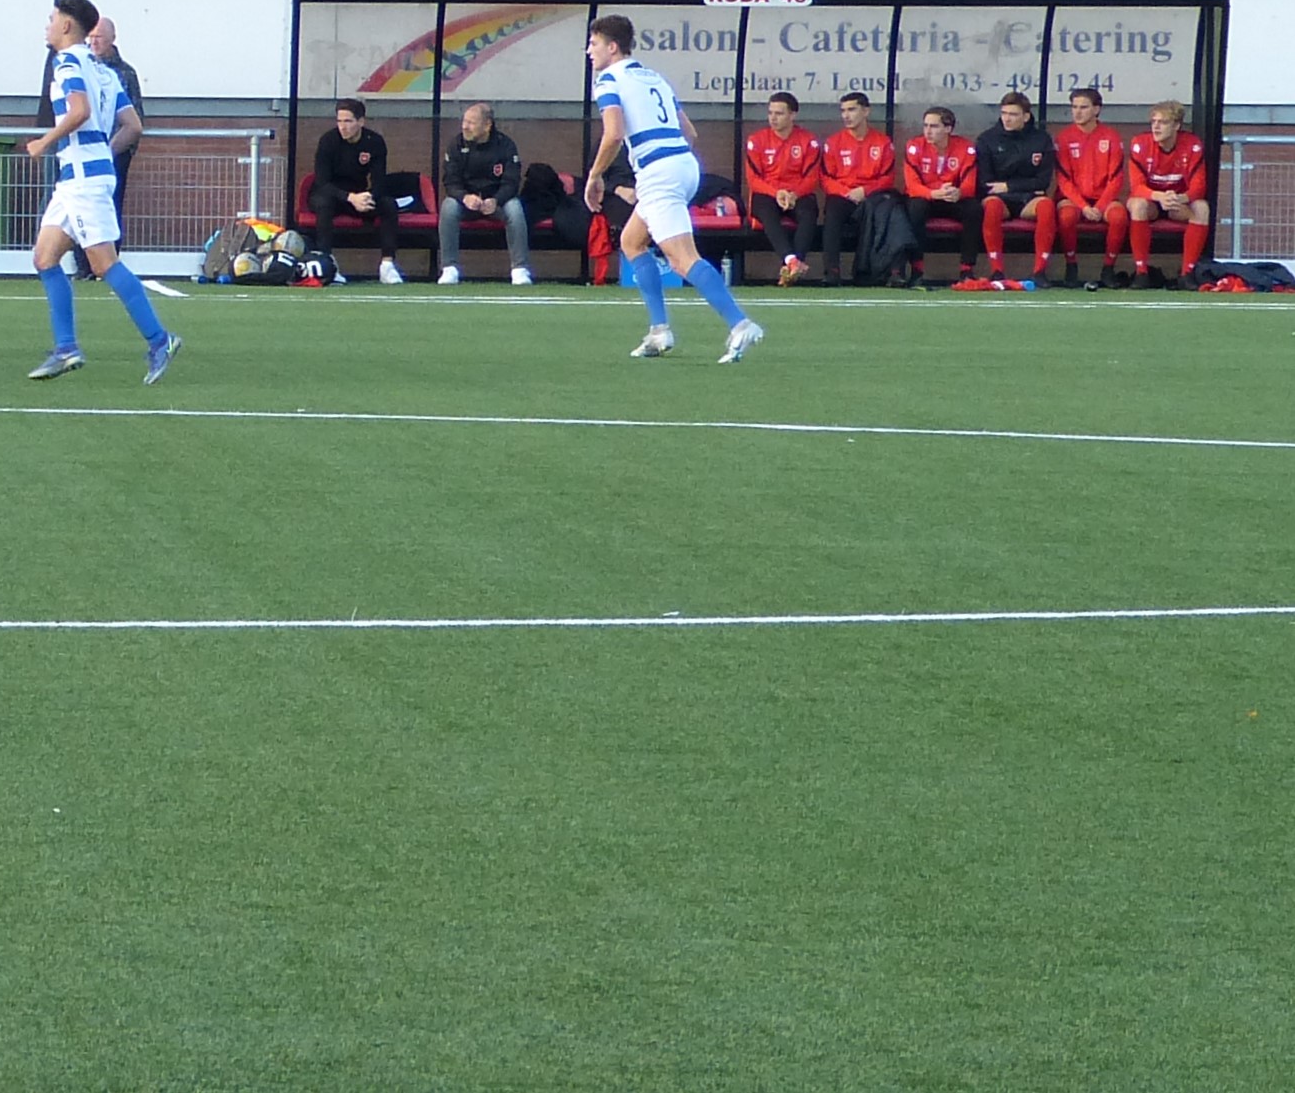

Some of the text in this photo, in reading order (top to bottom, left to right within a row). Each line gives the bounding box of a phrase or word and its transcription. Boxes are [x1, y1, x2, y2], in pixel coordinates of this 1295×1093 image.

[778, 19, 961, 53] Cafetaria
[693, 71, 797, 94] Lepelaar
[942, 72, 983, 92] 033
[649, 88, 669, 124] 3
